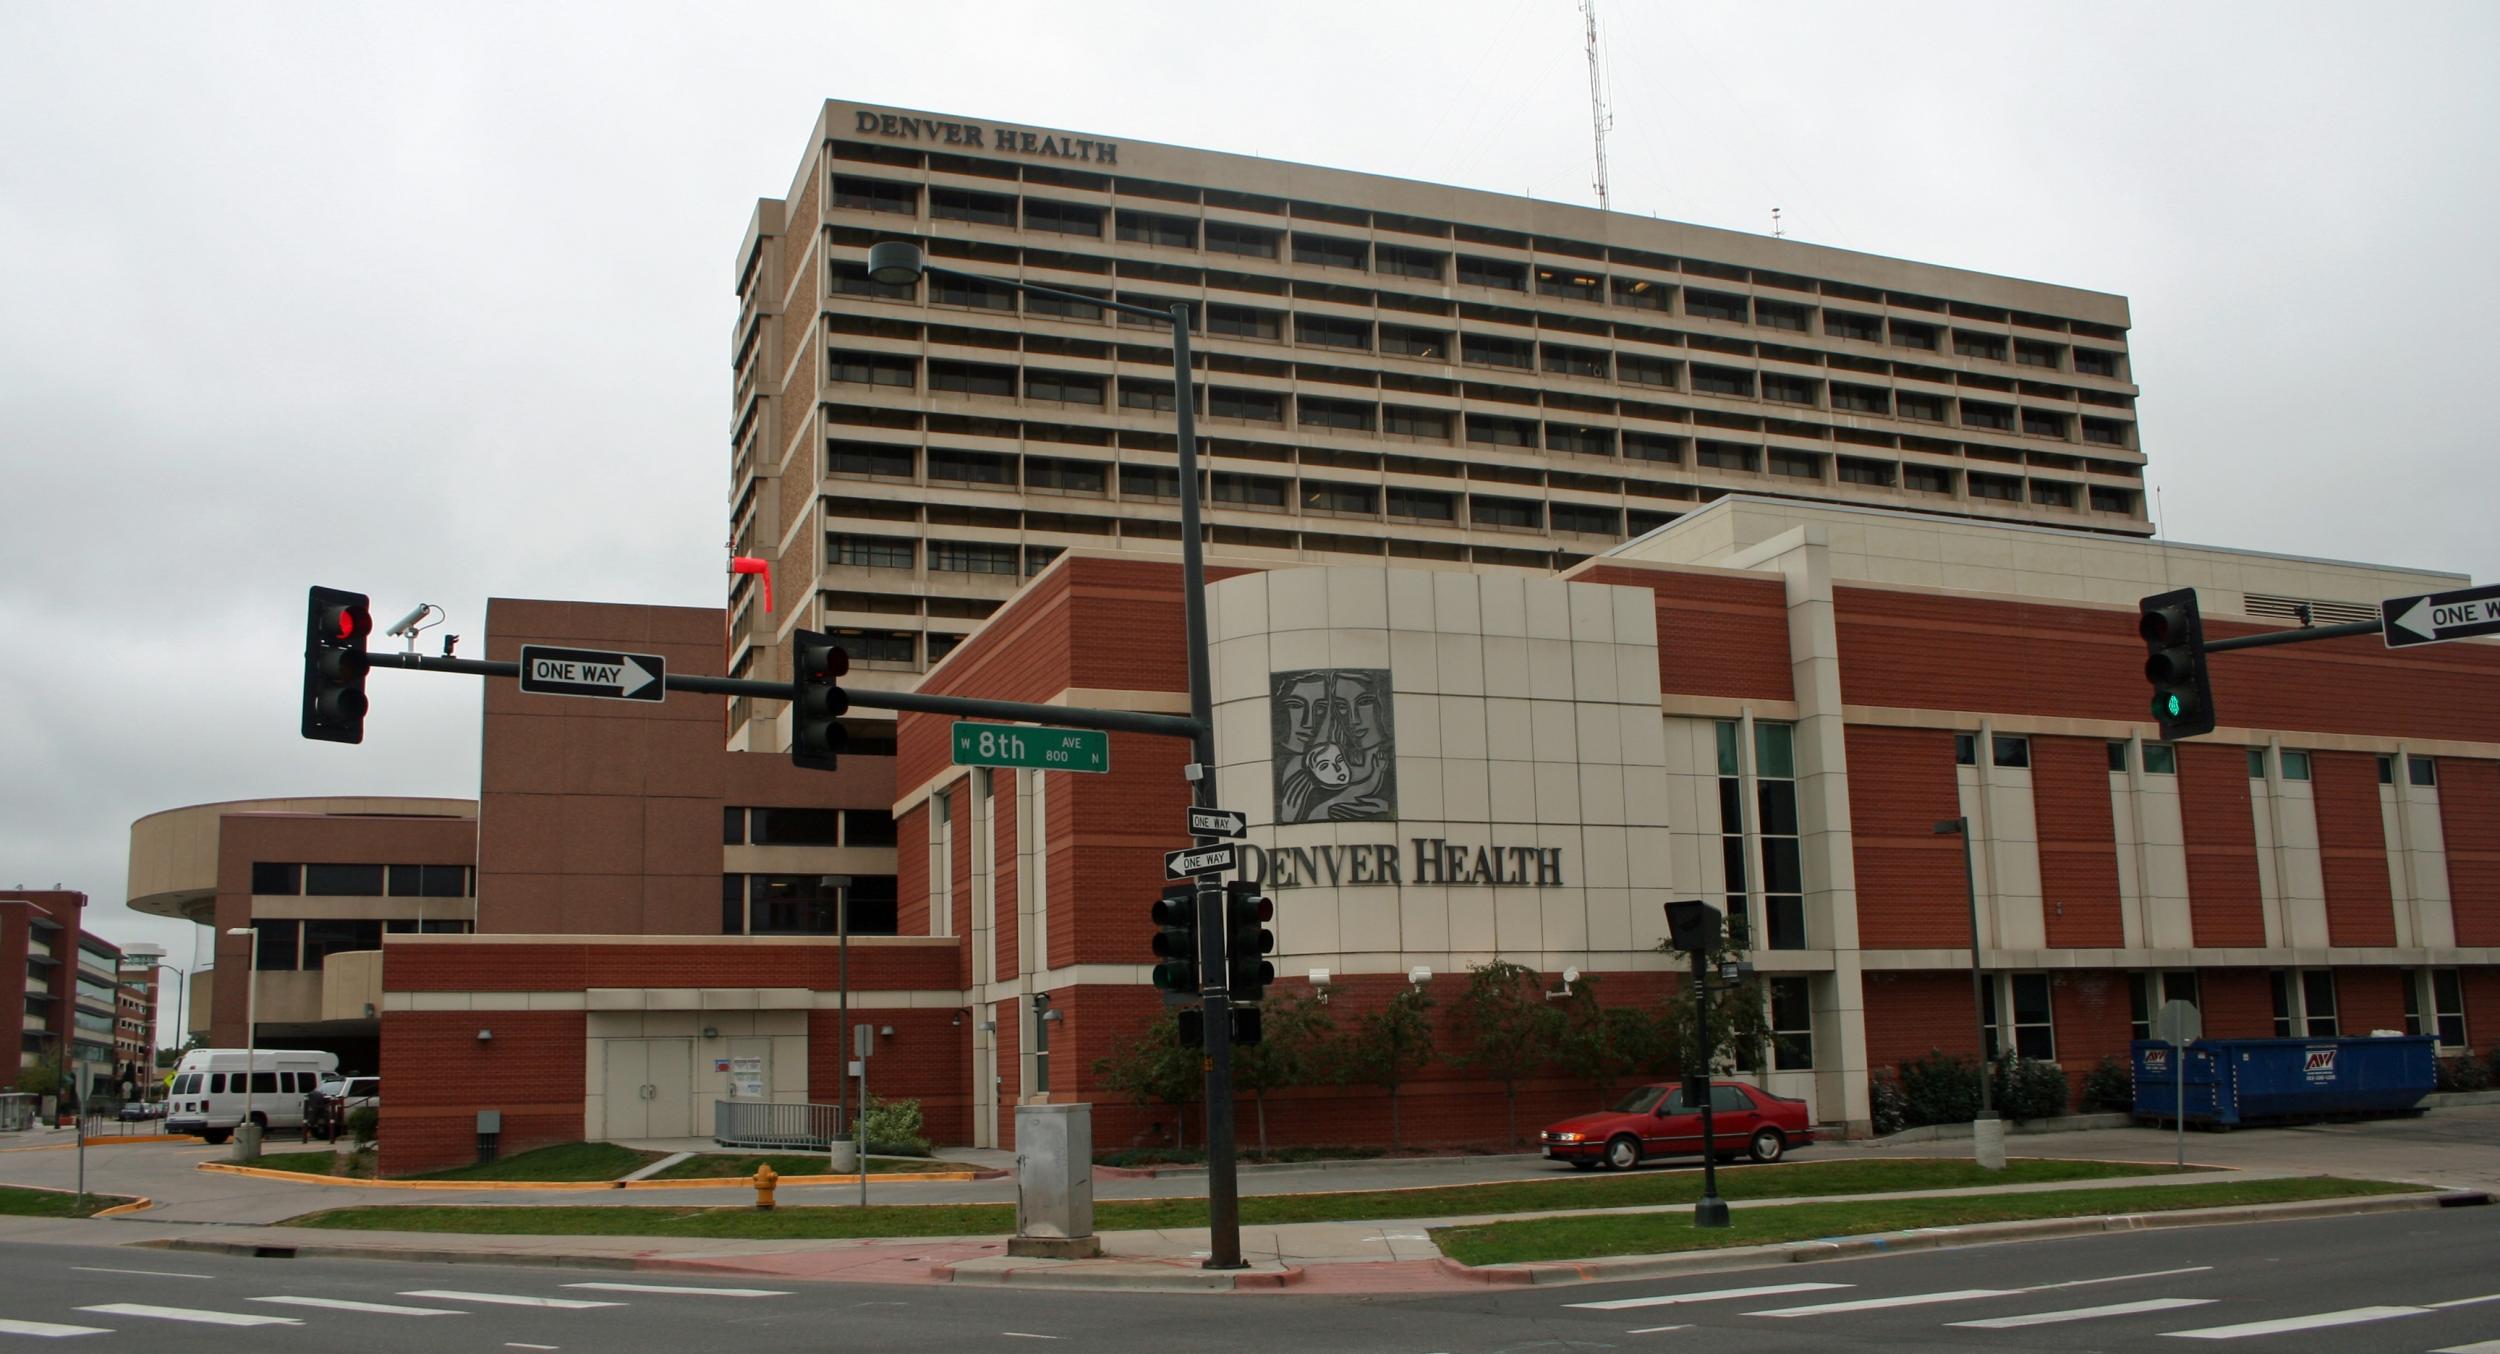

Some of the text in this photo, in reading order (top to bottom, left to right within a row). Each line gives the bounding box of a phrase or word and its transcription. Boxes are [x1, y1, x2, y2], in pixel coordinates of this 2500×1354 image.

[856, 111, 1118, 164] DENVER HEALTH
[2432, 604, 2479, 626] ONE
[537, 661, 622, 683] ONE WAY
[961, 731, 1082, 759] W 8th AVE
[1046, 750, 1099, 764] 800 N
[1194, 815, 1229, 830] ONE WAY
[1184, 852, 1225, 869] ONE WAY
[1237, 838, 1563, 888] DENVER HEALTH
